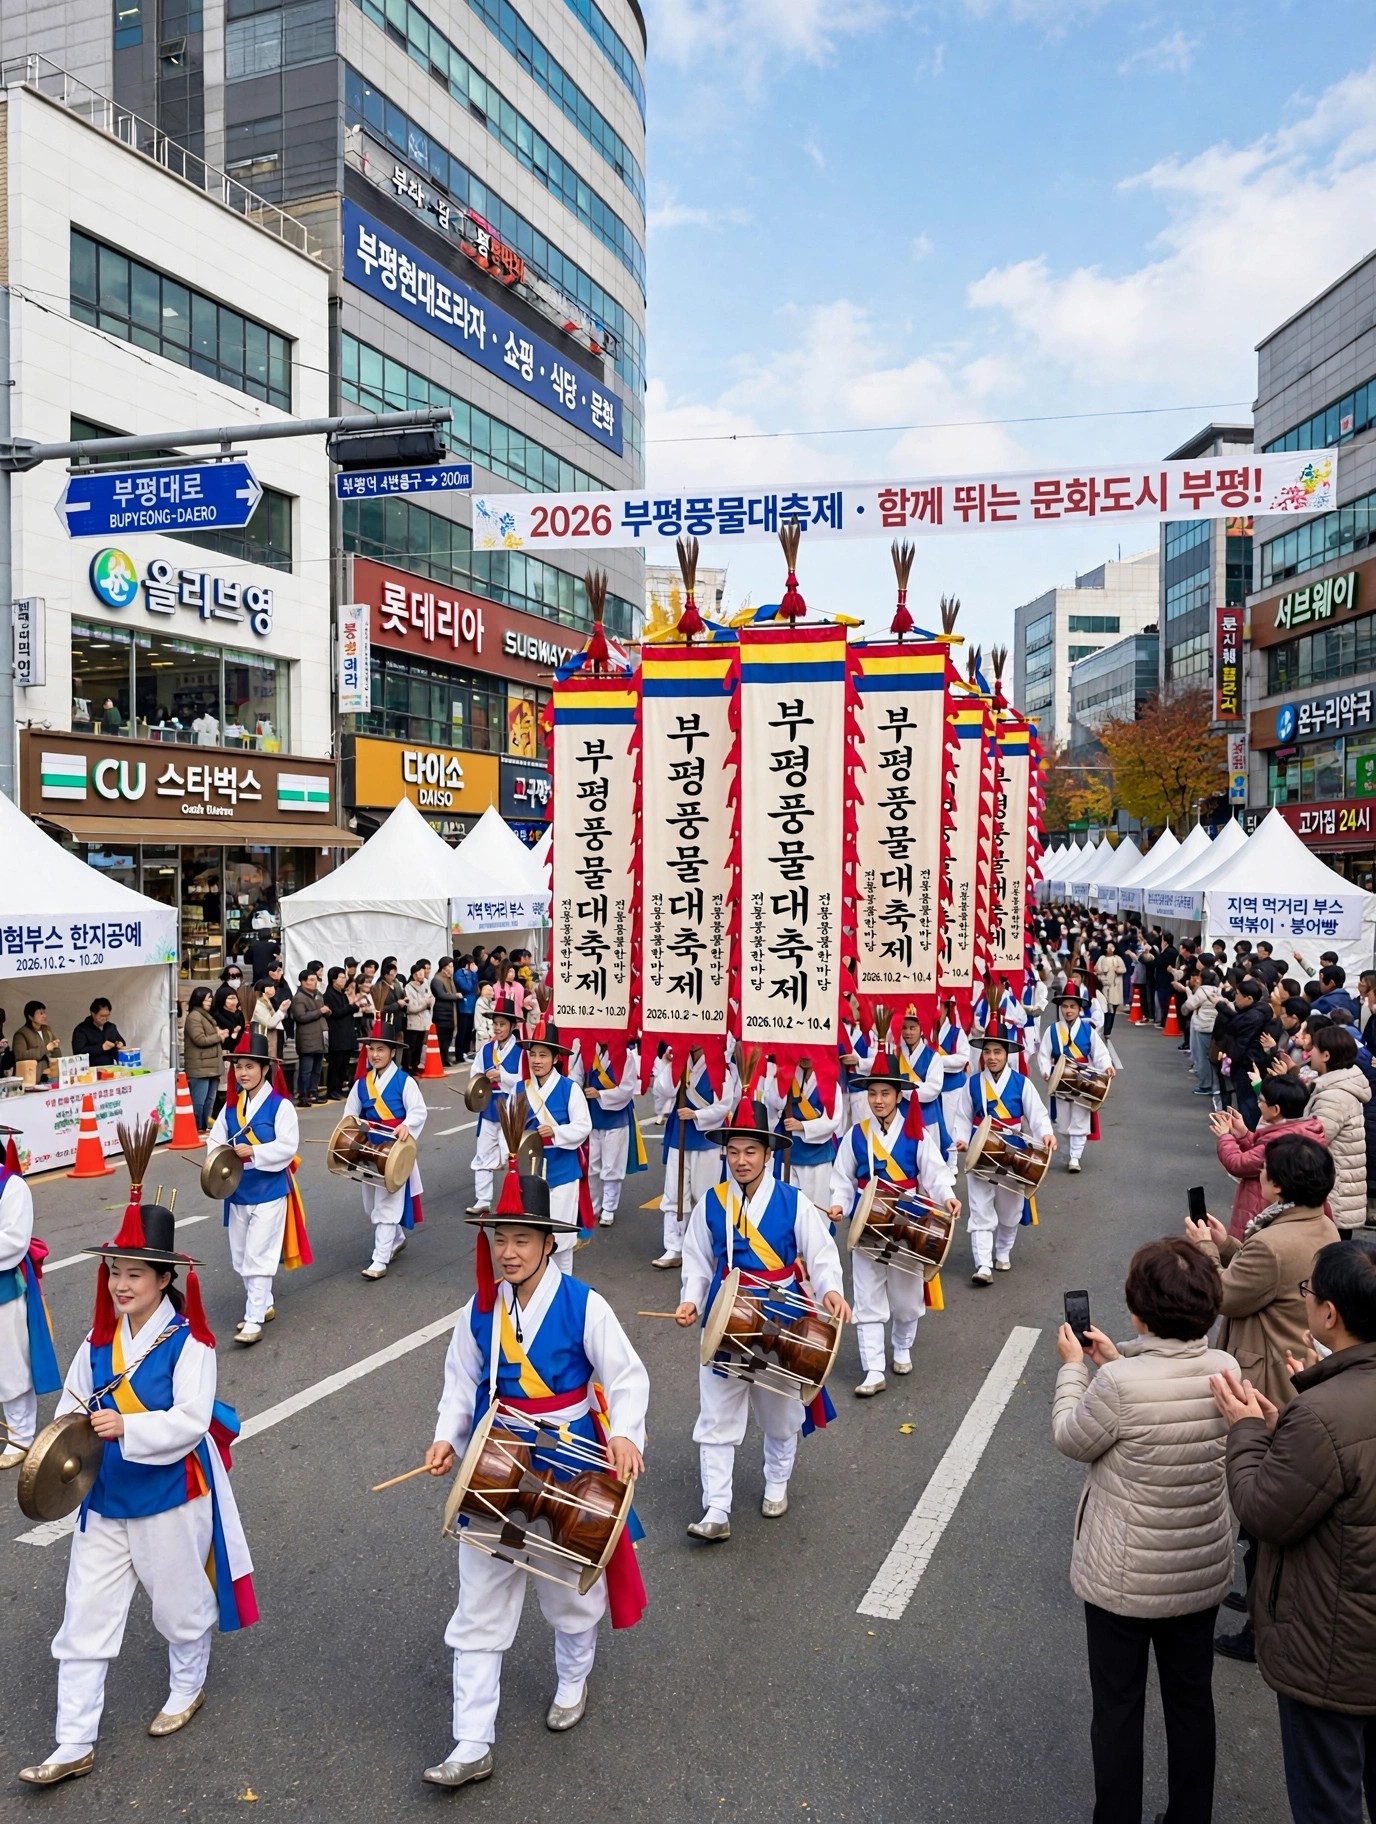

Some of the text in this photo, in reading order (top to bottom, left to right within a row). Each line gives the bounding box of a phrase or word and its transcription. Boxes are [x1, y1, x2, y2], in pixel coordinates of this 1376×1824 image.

[357, 224, 486, 350] 부평현대프라자
[503, 330, 535, 382] 쇼핑
[550, 362, 578, 410] 식당
[113, 473, 204, 508] 부평대로
[530, 504, 612, 538] 2026
[621, 491, 843, 538] 부평풍물대축제
[877, 486, 943, 527] 함께
[953, 483, 1021, 523] 뛰는
[1030, 471, 1168, 520] 문화도시
[1178, 466, 1262, 512] 부평!
[110, 505, 217, 528] BUPYEONG-DAERO
[141, 559, 274, 636] 올리브영
[1273, 571, 1356, 630] 서브웨이
[380, 580, 485, 654] 롯데리아
[1297, 690, 1372, 735] 온누리약국
[92, 758, 262, 805] CU 스타벅스
[403, 750, 465, 789] 다이소
[419, 788, 454, 807] DAISO
[877, 706, 917, 968] 부평풍물대축제
[1339, 806, 1370, 832] 24시
[574, 738, 614, 1001] 부평풍물대축제
[665, 713, 710, 1006] 부평풍물대축제
[767, 697, 815, 1013] 부평풍물대축제
[1227, 896, 1344, 916] 지역 먹거리 부스
[0, 921, 142, 956] 험부스 한지공예
[1229, 916, 1274, 934] 떡볶이
[16, 955, 66, 972] 2026.10.2
[79, 953, 104, 966] 10.20
[912, 972, 932, 983] 10.4
[952, 968, 969, 978] 10.4
[701, 1010, 724, 1021] 10.20
[807, 1017, 831, 1031] 10.4
